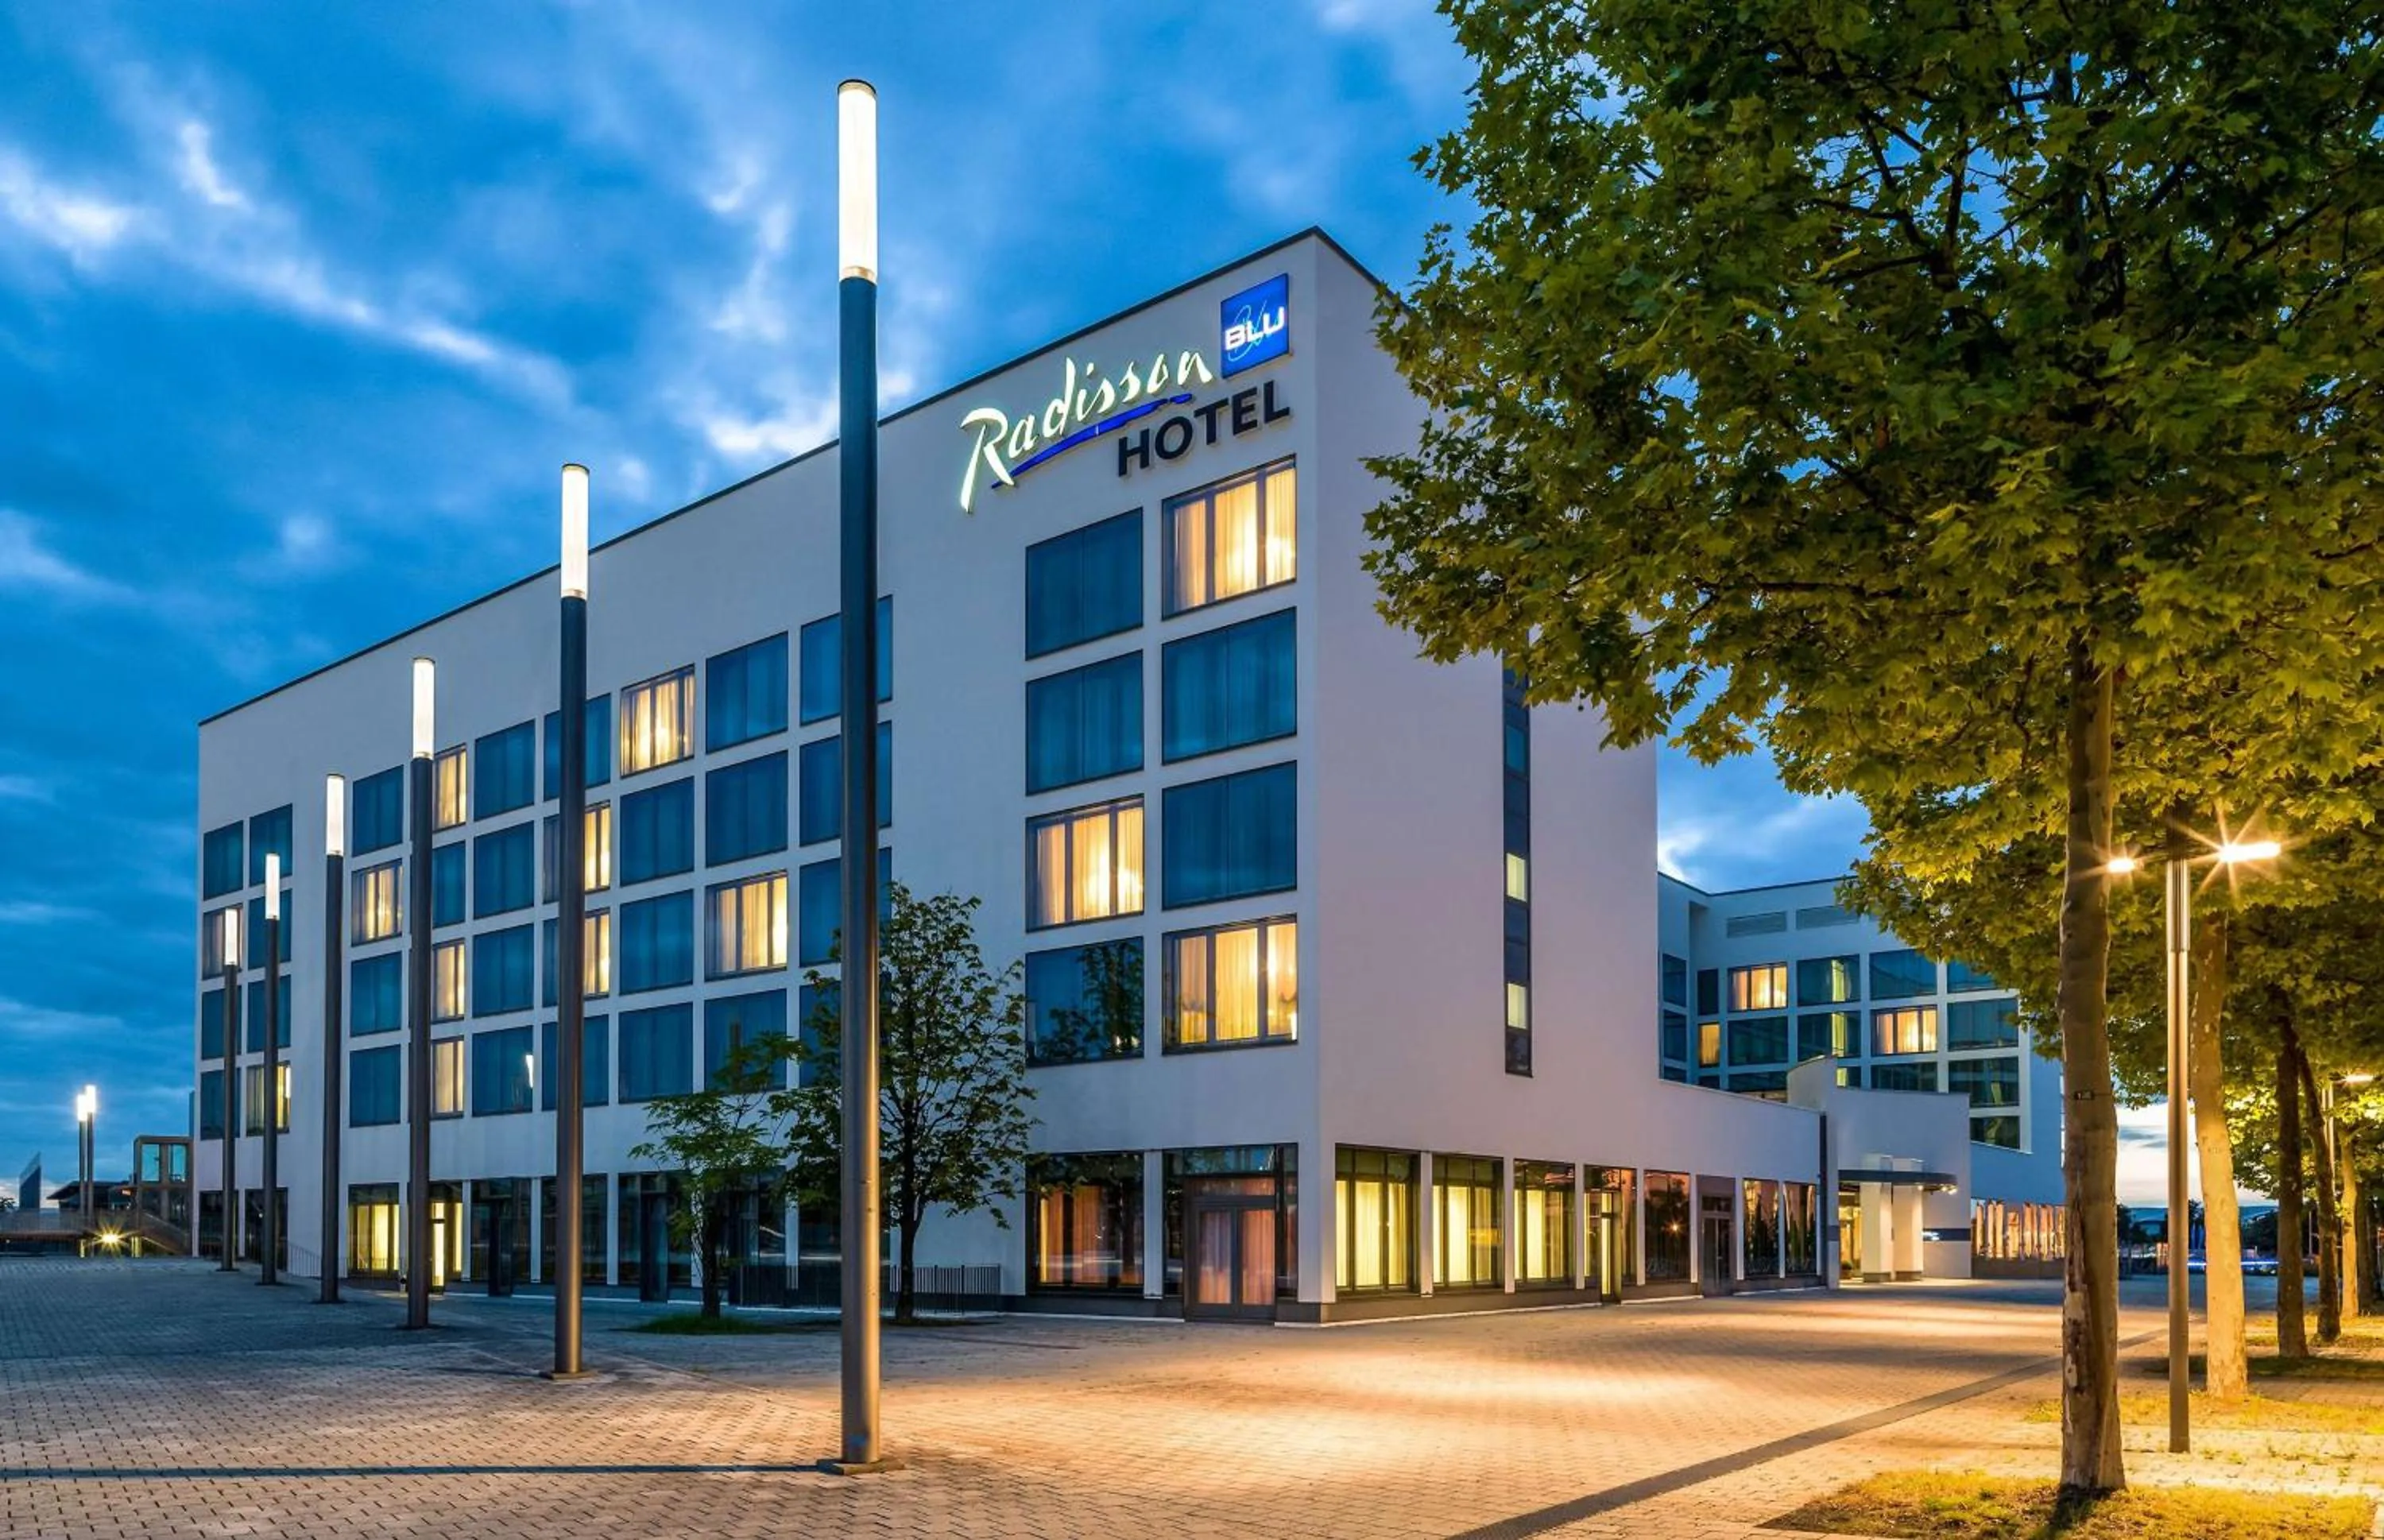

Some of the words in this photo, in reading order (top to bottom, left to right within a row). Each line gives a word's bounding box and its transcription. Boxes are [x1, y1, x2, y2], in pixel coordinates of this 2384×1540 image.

[960, 350, 1213, 513] Radisson
[1225, 306, 1285, 350] BLU
[1118, 381, 1291, 477] HOTEL
